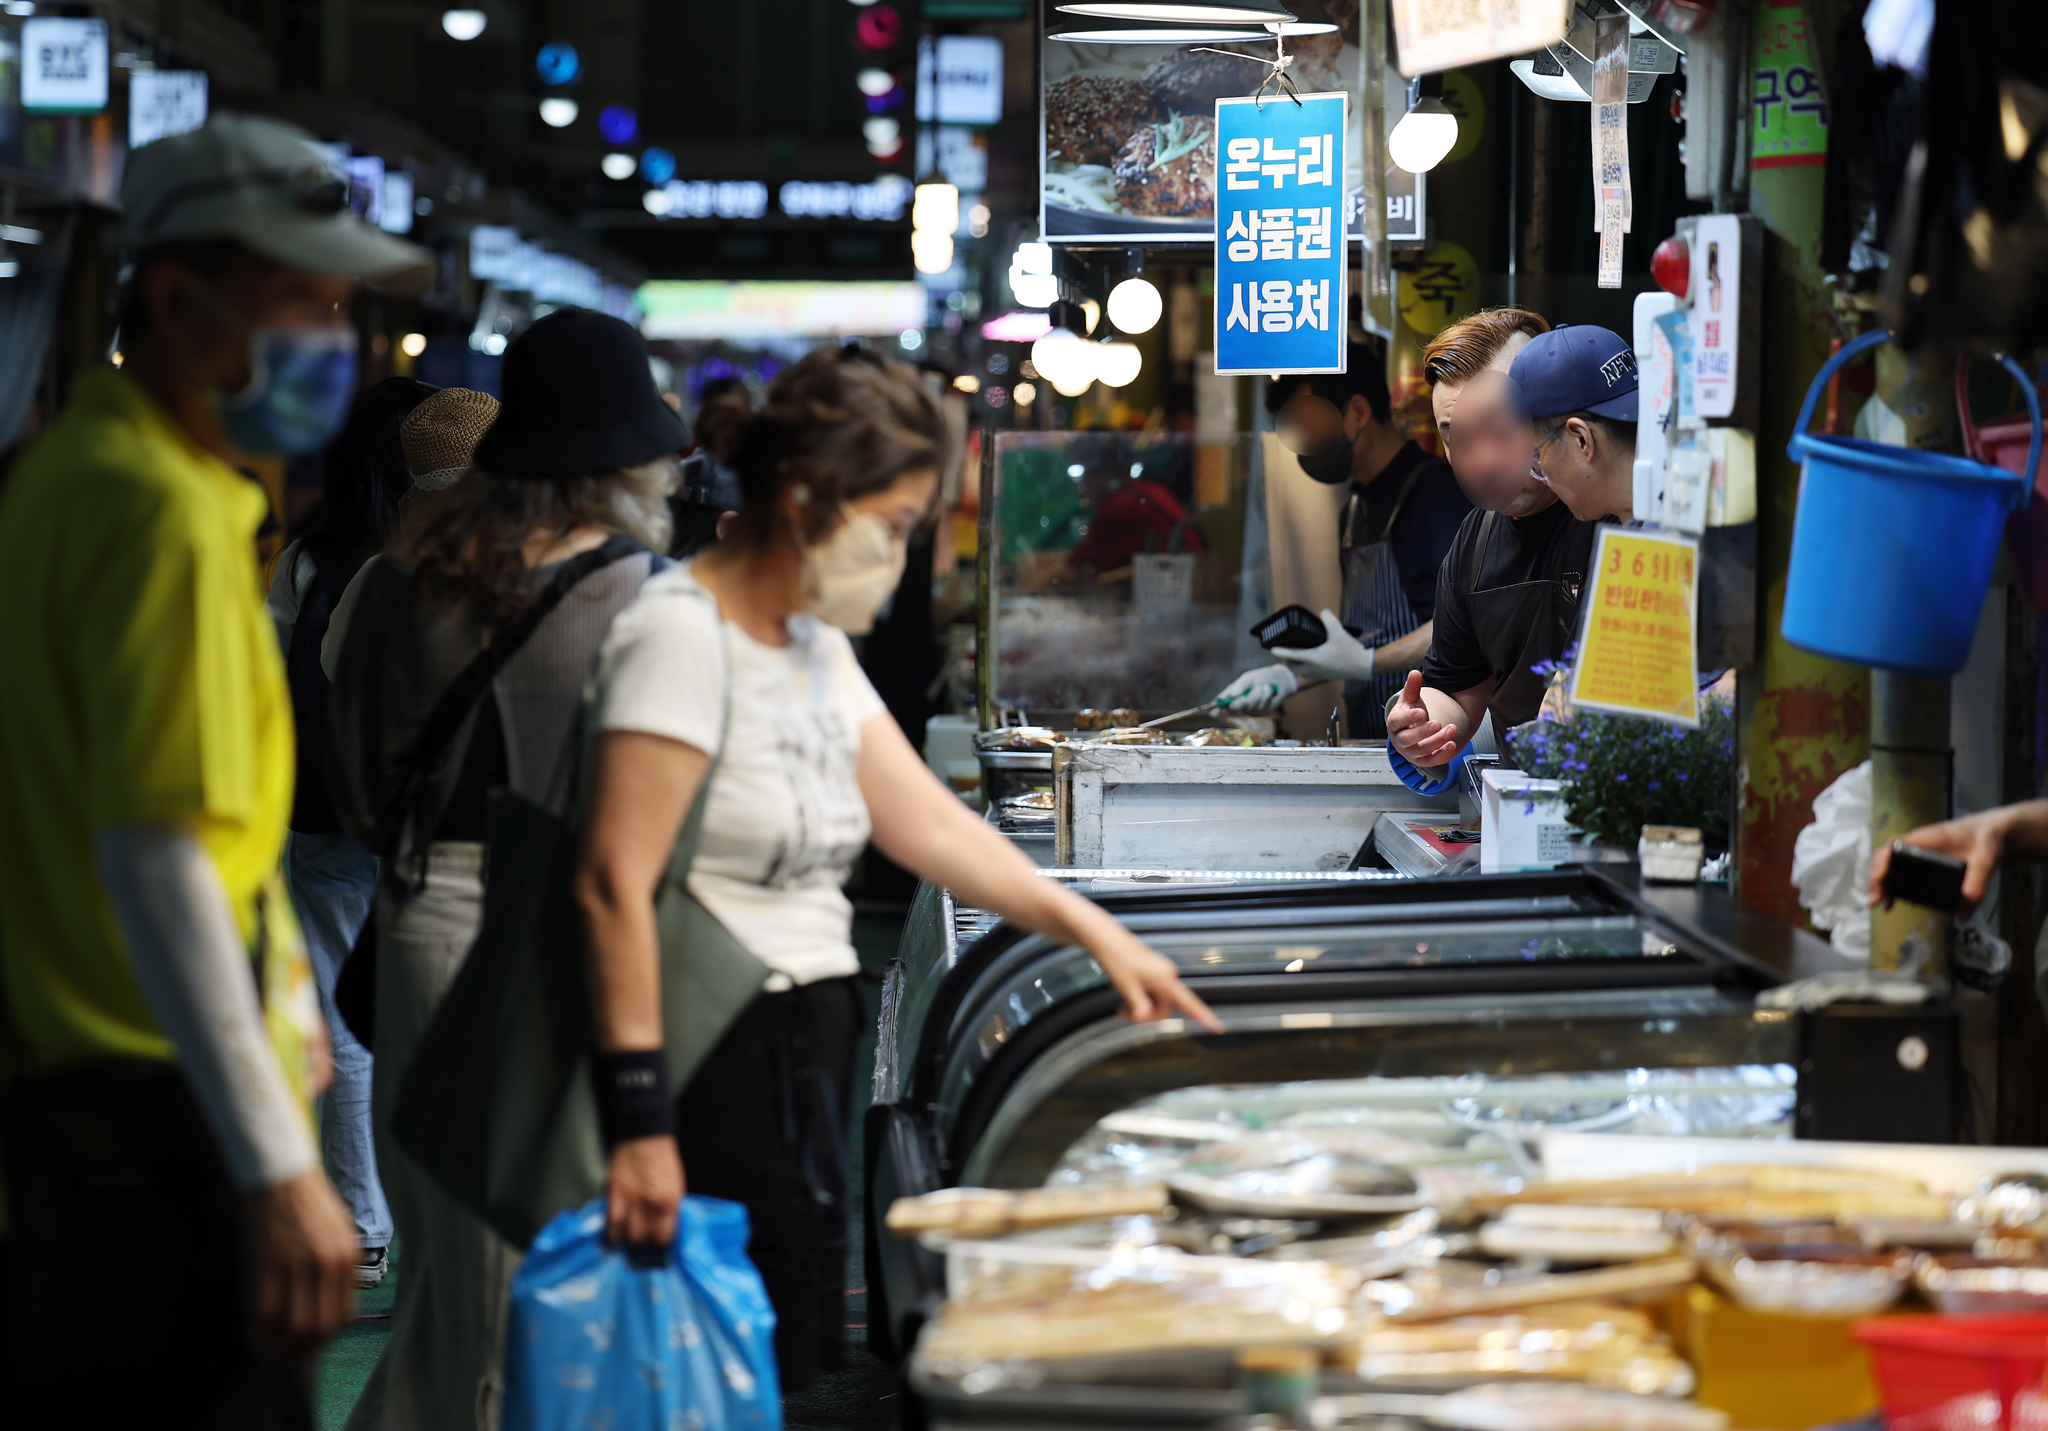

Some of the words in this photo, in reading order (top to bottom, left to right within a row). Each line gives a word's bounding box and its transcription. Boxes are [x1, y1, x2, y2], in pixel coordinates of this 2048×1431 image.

[1225, 133, 1334, 191] 온누리
[1226, 206, 1332, 262] 상품권
[1226, 278, 1330, 333] 사용처
